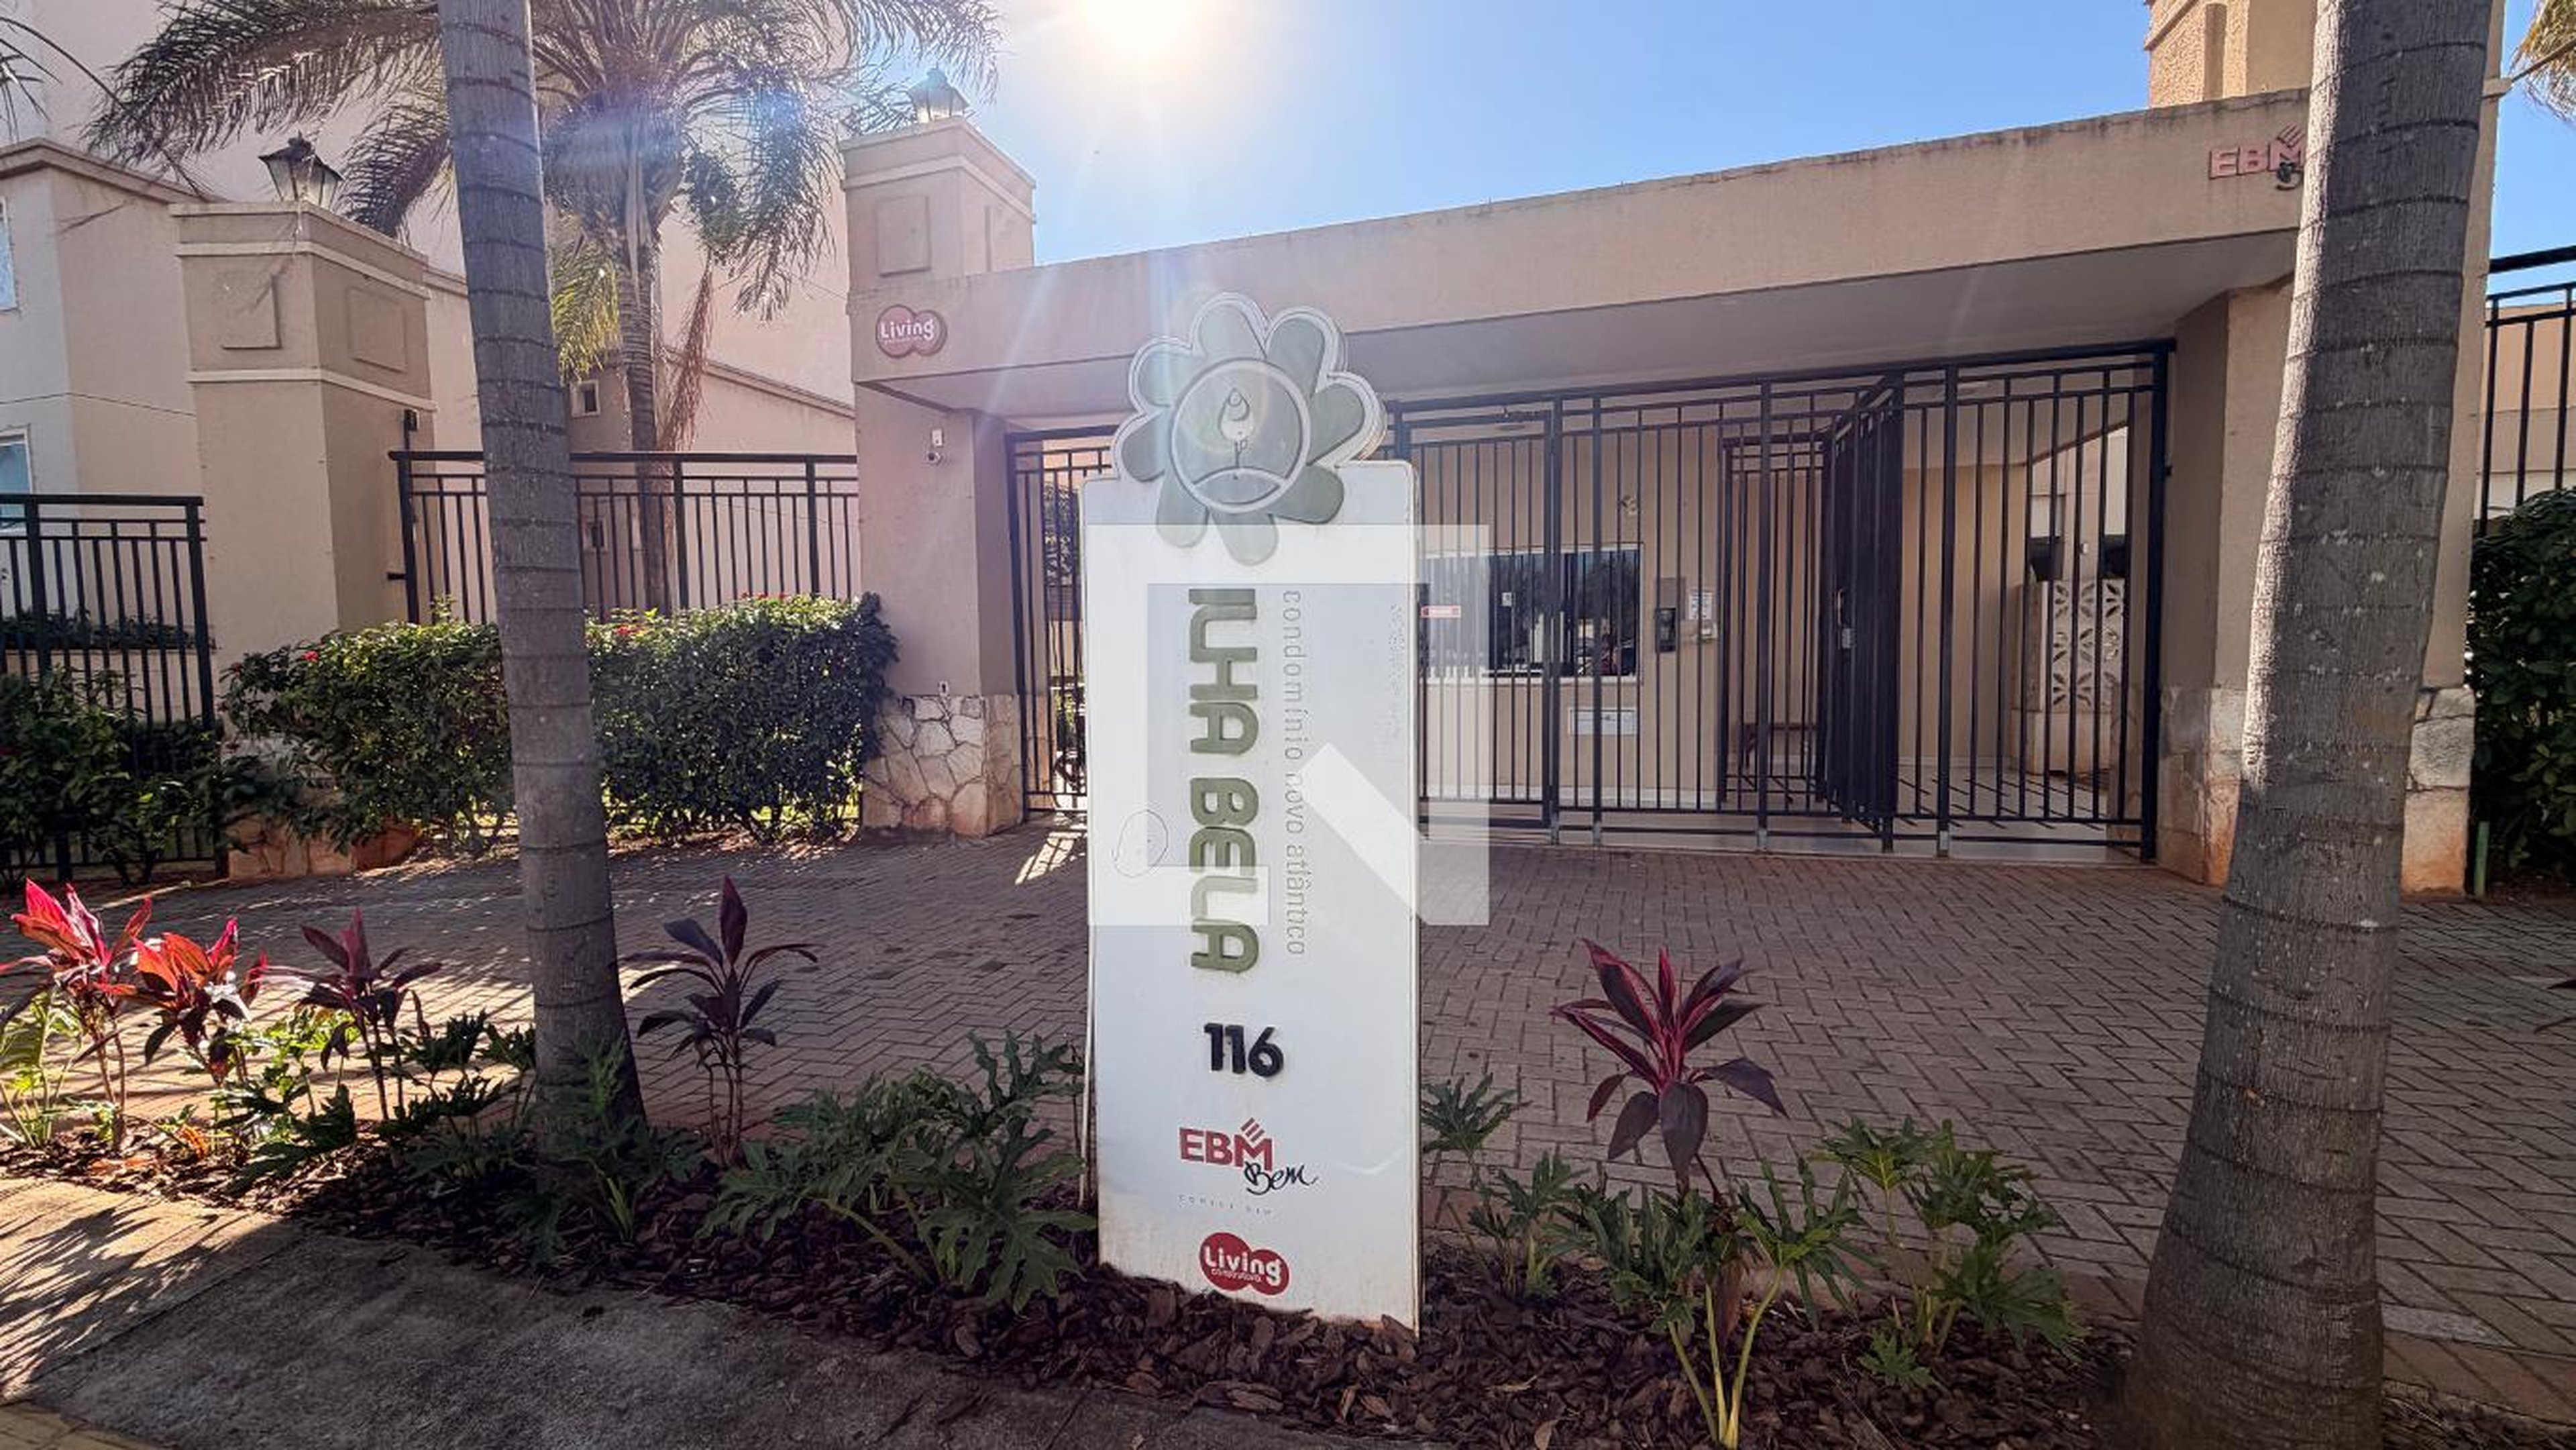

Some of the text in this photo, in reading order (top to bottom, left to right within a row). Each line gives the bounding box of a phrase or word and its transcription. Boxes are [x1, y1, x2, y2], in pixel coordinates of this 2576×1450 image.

[2209, 142, 2305, 179] EBM
[881, 319, 934, 341] Living
[1189, 589, 1258, 974] ILHA BELA
[1283, 590, 1312, 955] condomínio novo atlântico
[1204, 1023, 1284, 1078] 116
[1179, 1127, 1273, 1172] EBM
[1244, 1161, 1318, 1195] Bem
[1205, 1246, 1281, 1286] Living
